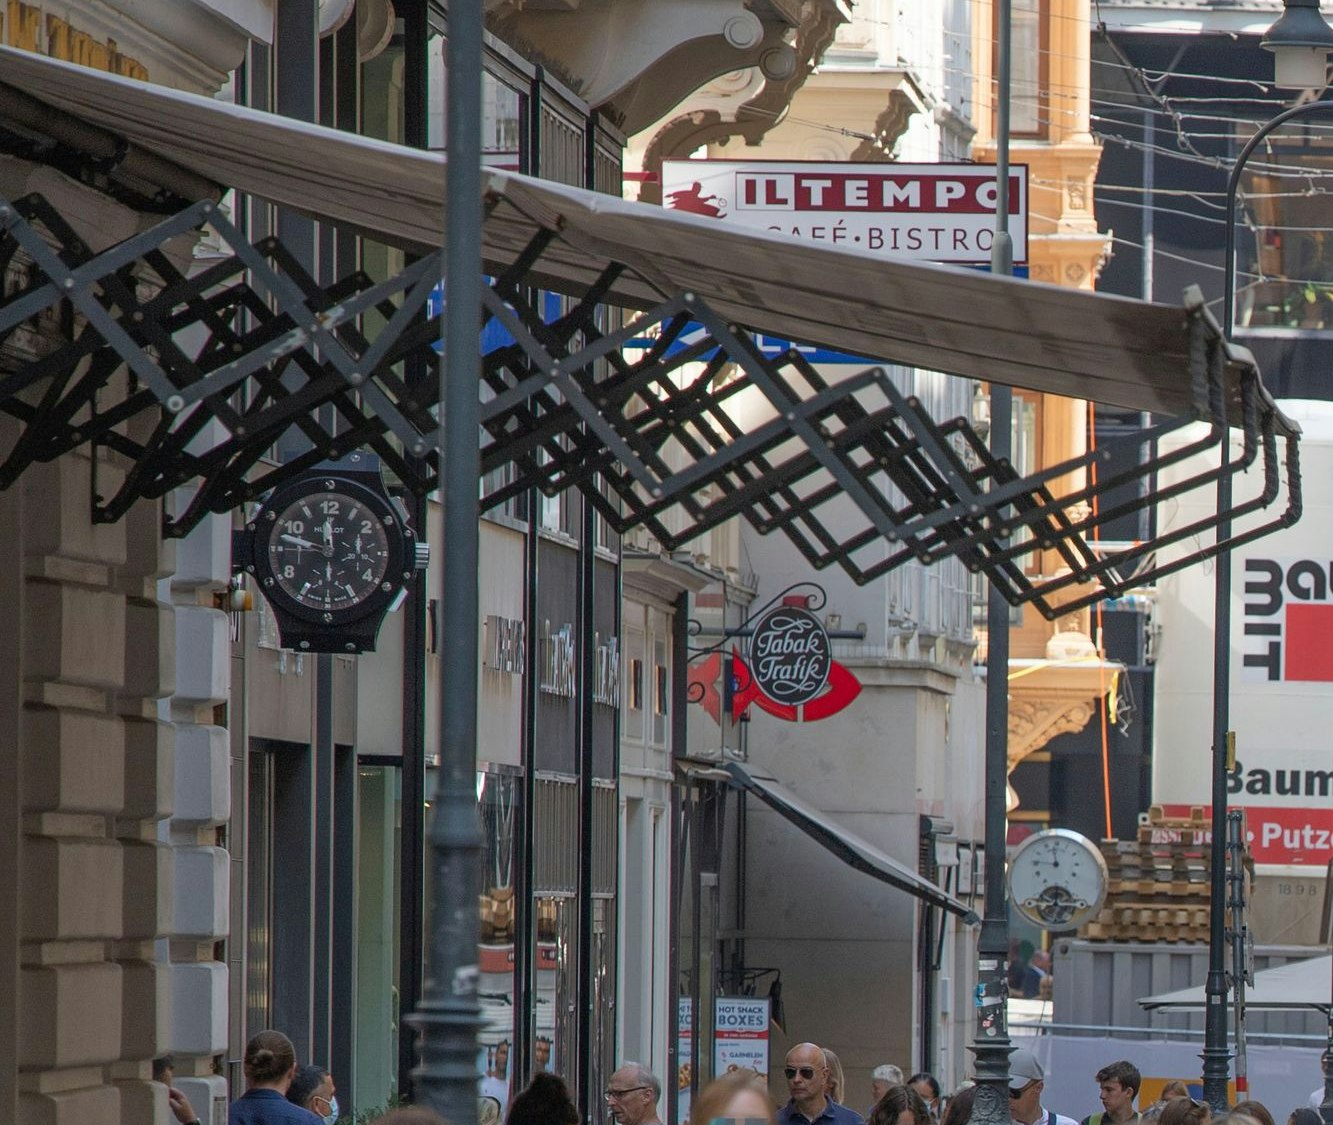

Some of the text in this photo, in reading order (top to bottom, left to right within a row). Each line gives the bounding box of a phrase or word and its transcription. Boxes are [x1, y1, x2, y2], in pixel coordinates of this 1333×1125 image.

[868, 228, 995, 250] BISTRO
[320, 501, 340, 514] 12
[285, 521, 304, 534] 10
[361, 520, 372, 533] 2
[284, 565, 373, 582] 8 4
[757, 629, 824, 657] Tabak
[758, 655, 824, 686] Trafik
[718, 1015, 763, 1025] BOXES
